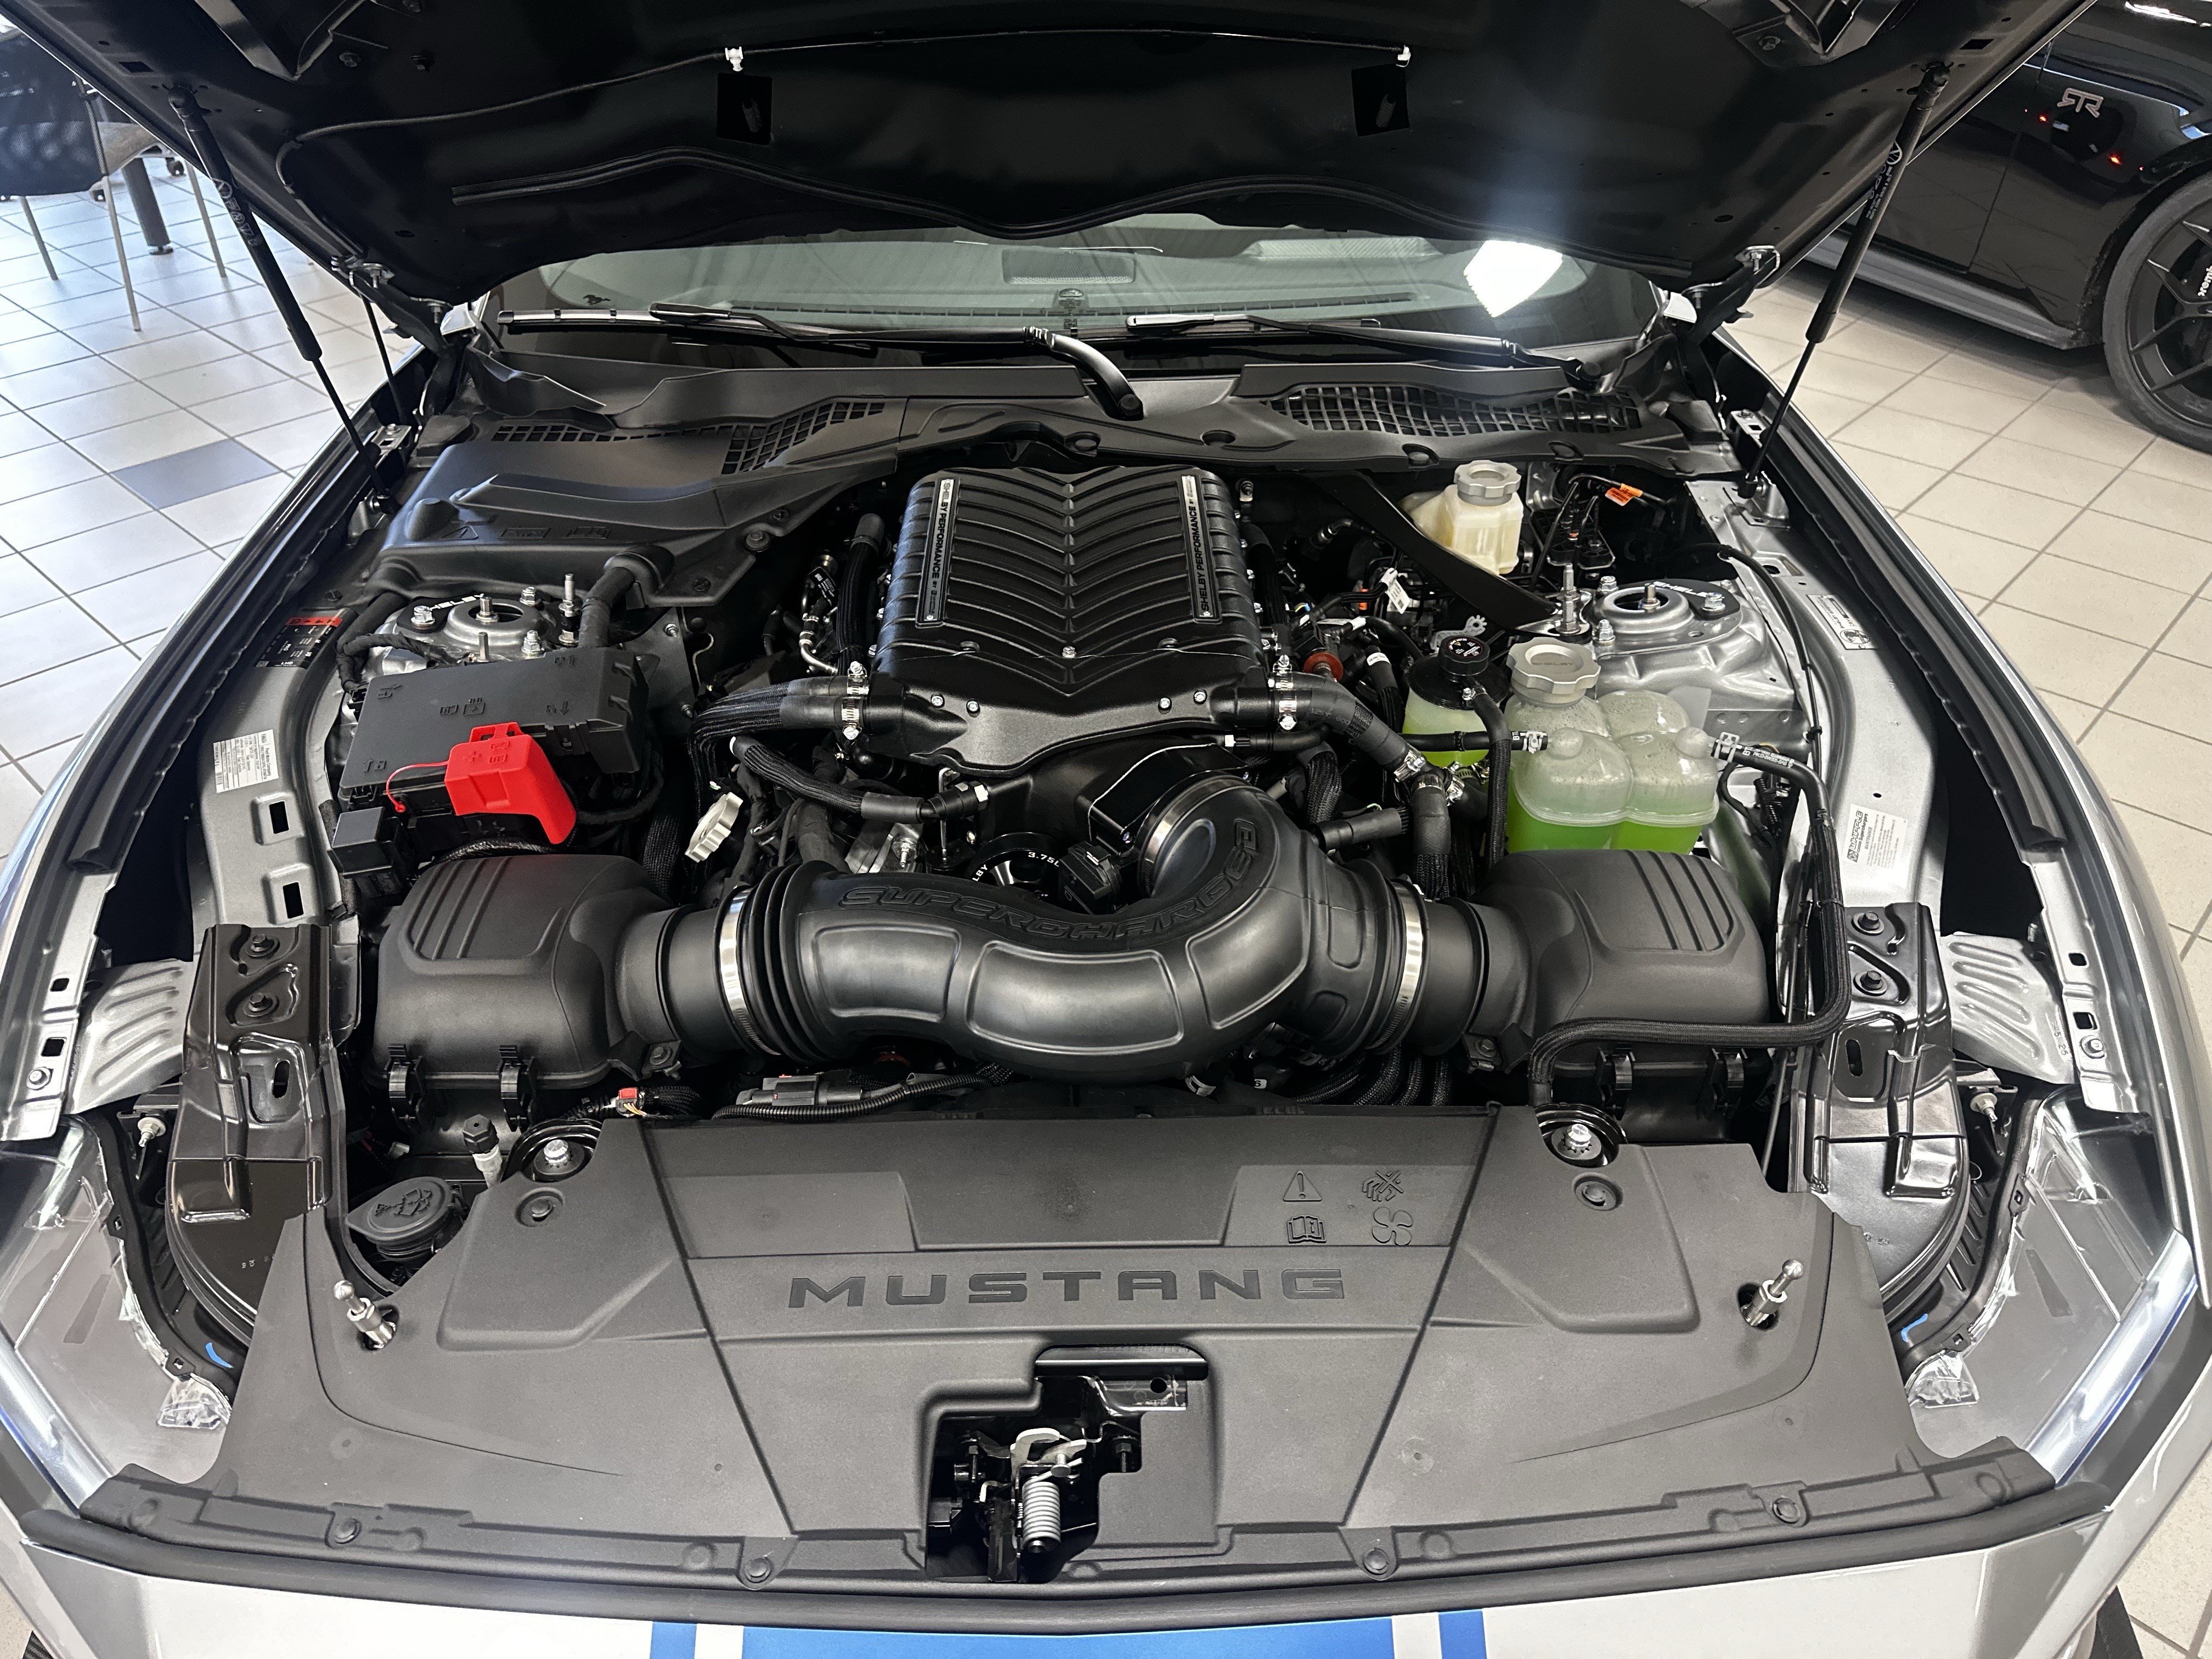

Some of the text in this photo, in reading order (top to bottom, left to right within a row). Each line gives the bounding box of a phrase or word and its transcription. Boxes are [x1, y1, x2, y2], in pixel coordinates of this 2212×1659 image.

[941, 483, 952, 511] SHELBY
[932, 513, 947, 579] PERFORMANCE
[1188, 505, 1205, 571] PERFORMANCE
[430, 593, 484, 611] HELBY
[1195, 573, 1210, 612] SHELBY
[1653, 581, 1710, 598] SHELB
[1849, 810, 1863, 850] WHIPPLE
[839, 817, 1260, 941] SUPERCHARGED
[788, 1268, 1345, 1308] MUSTANG
